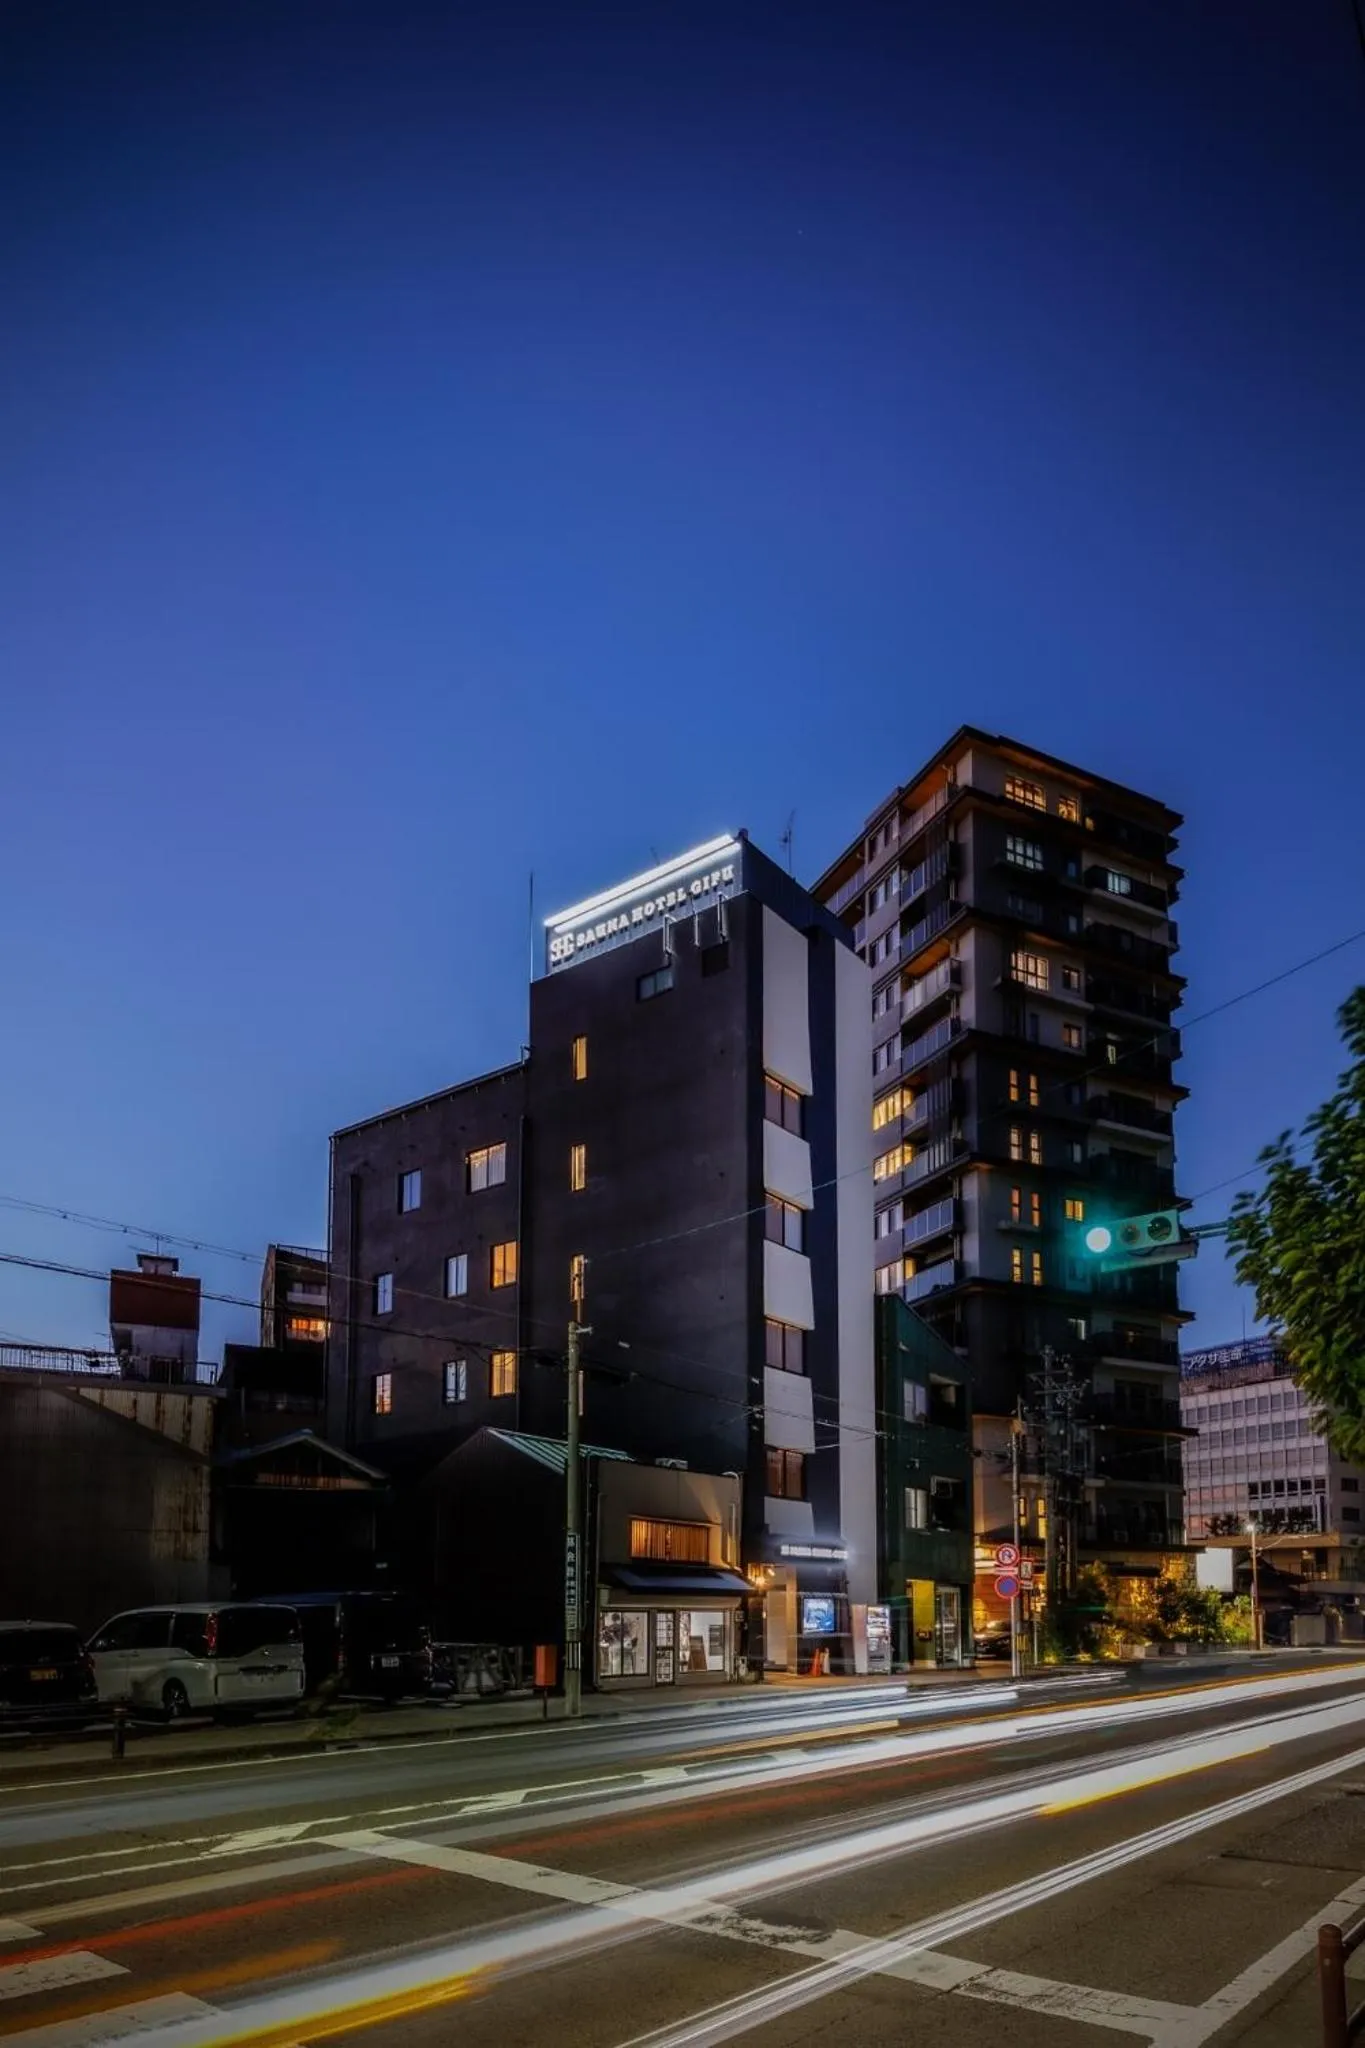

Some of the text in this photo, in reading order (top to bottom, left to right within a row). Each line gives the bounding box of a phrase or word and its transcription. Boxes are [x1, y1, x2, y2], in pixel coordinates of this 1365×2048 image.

[577, 865, 734, 947] SAUNA HOTEL GIFU
